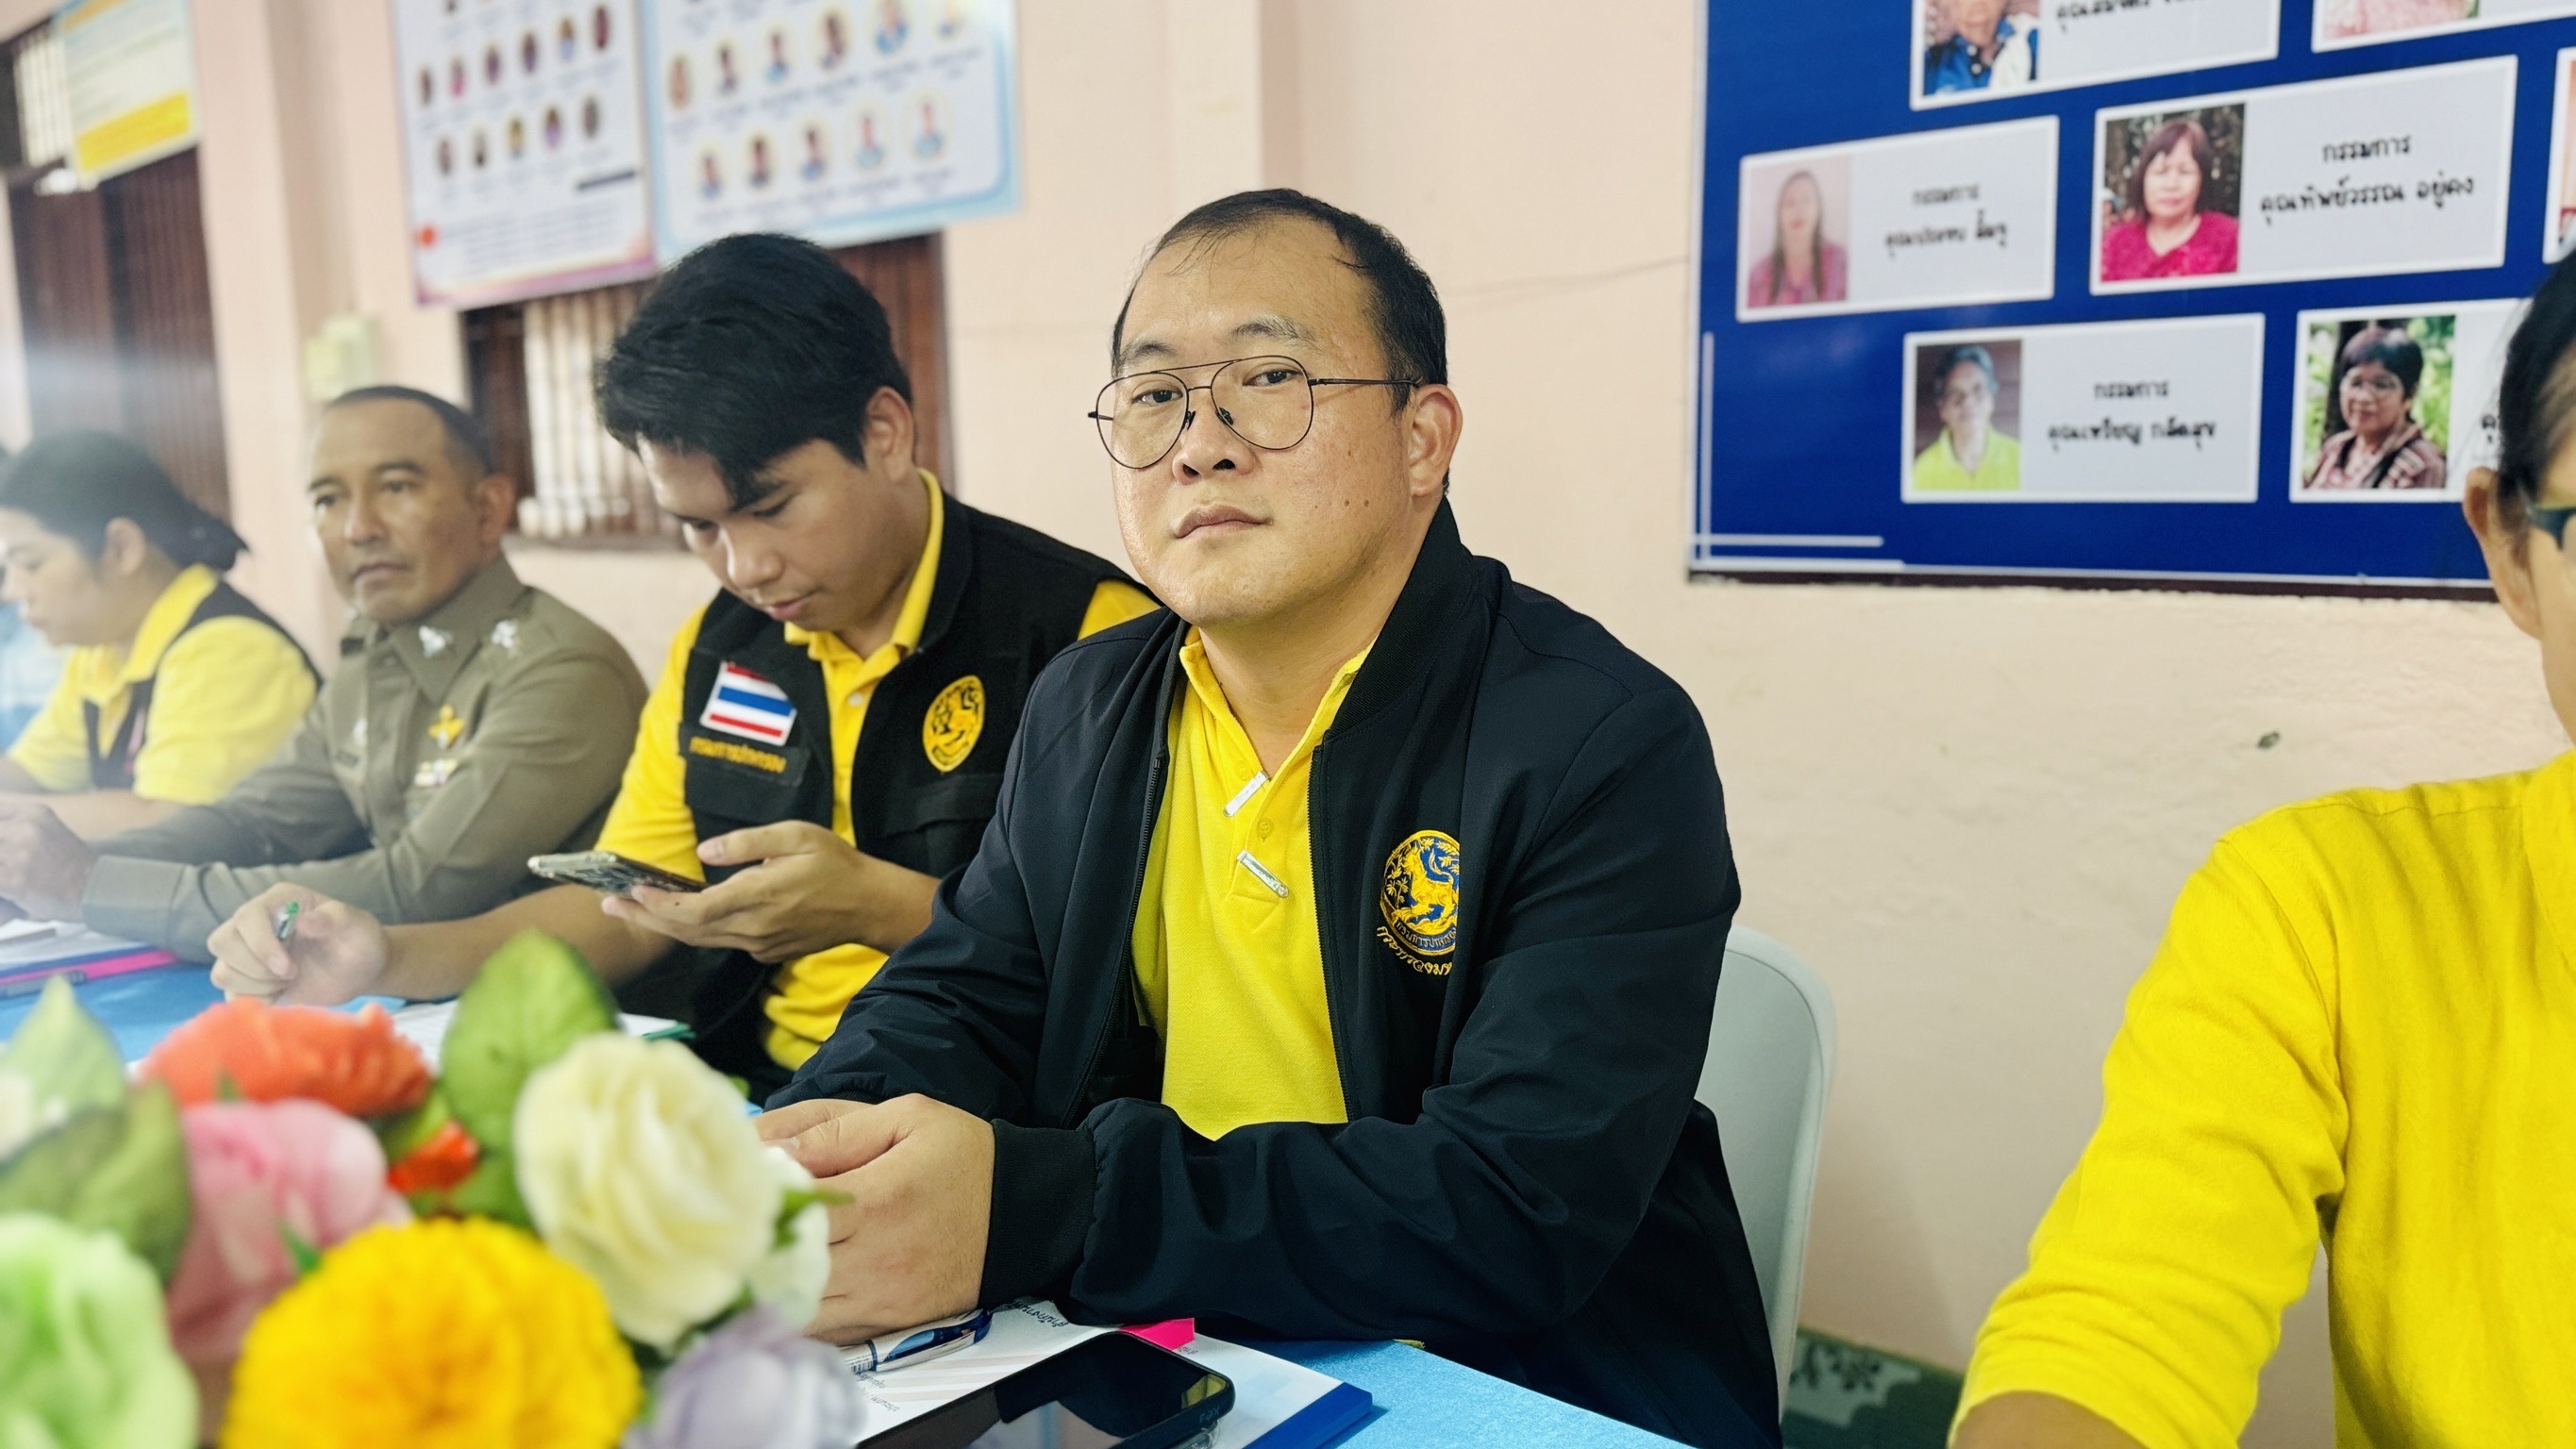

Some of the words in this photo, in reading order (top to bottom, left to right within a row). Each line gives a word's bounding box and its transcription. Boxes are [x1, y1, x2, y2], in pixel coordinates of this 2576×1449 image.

[2322, 135, 2413, 163] กรรมการ
[2260, 175, 2405, 226] คุณทิพย์วรรณ
[2094, 381, 2169, 400] กรรมการ
[1396, 919, 1457, 949] กรมการปกครอ
